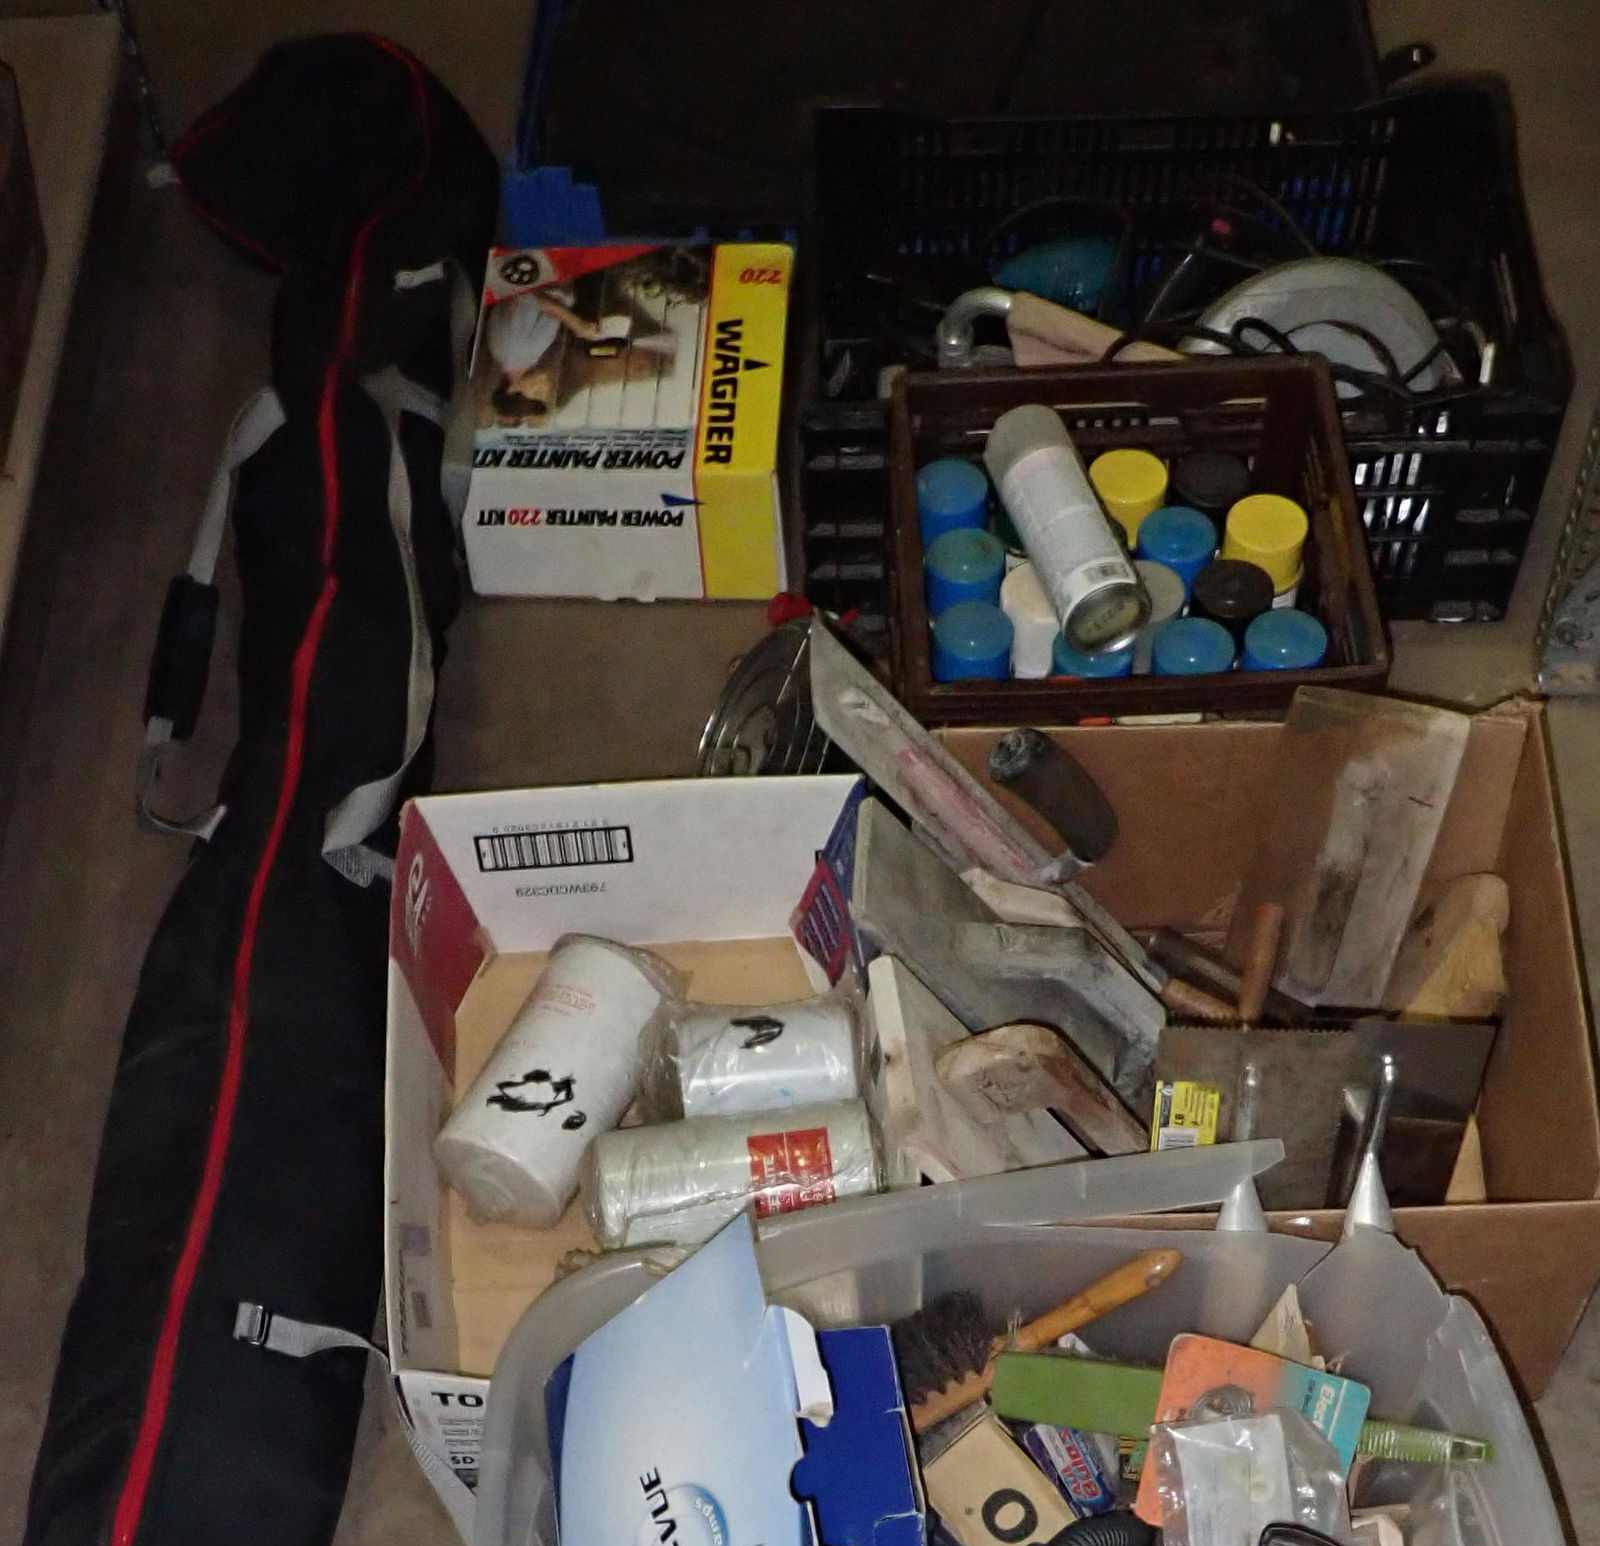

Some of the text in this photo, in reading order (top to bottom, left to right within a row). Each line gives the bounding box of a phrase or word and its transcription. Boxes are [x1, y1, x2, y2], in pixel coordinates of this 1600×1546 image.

[704, 318, 743, 464] WAGNER
[506, 448, 600, 468] PAINTER
[603, 449, 687, 468] POWER
[476, 508, 684, 526] POWER PAINTER 220 KIT
